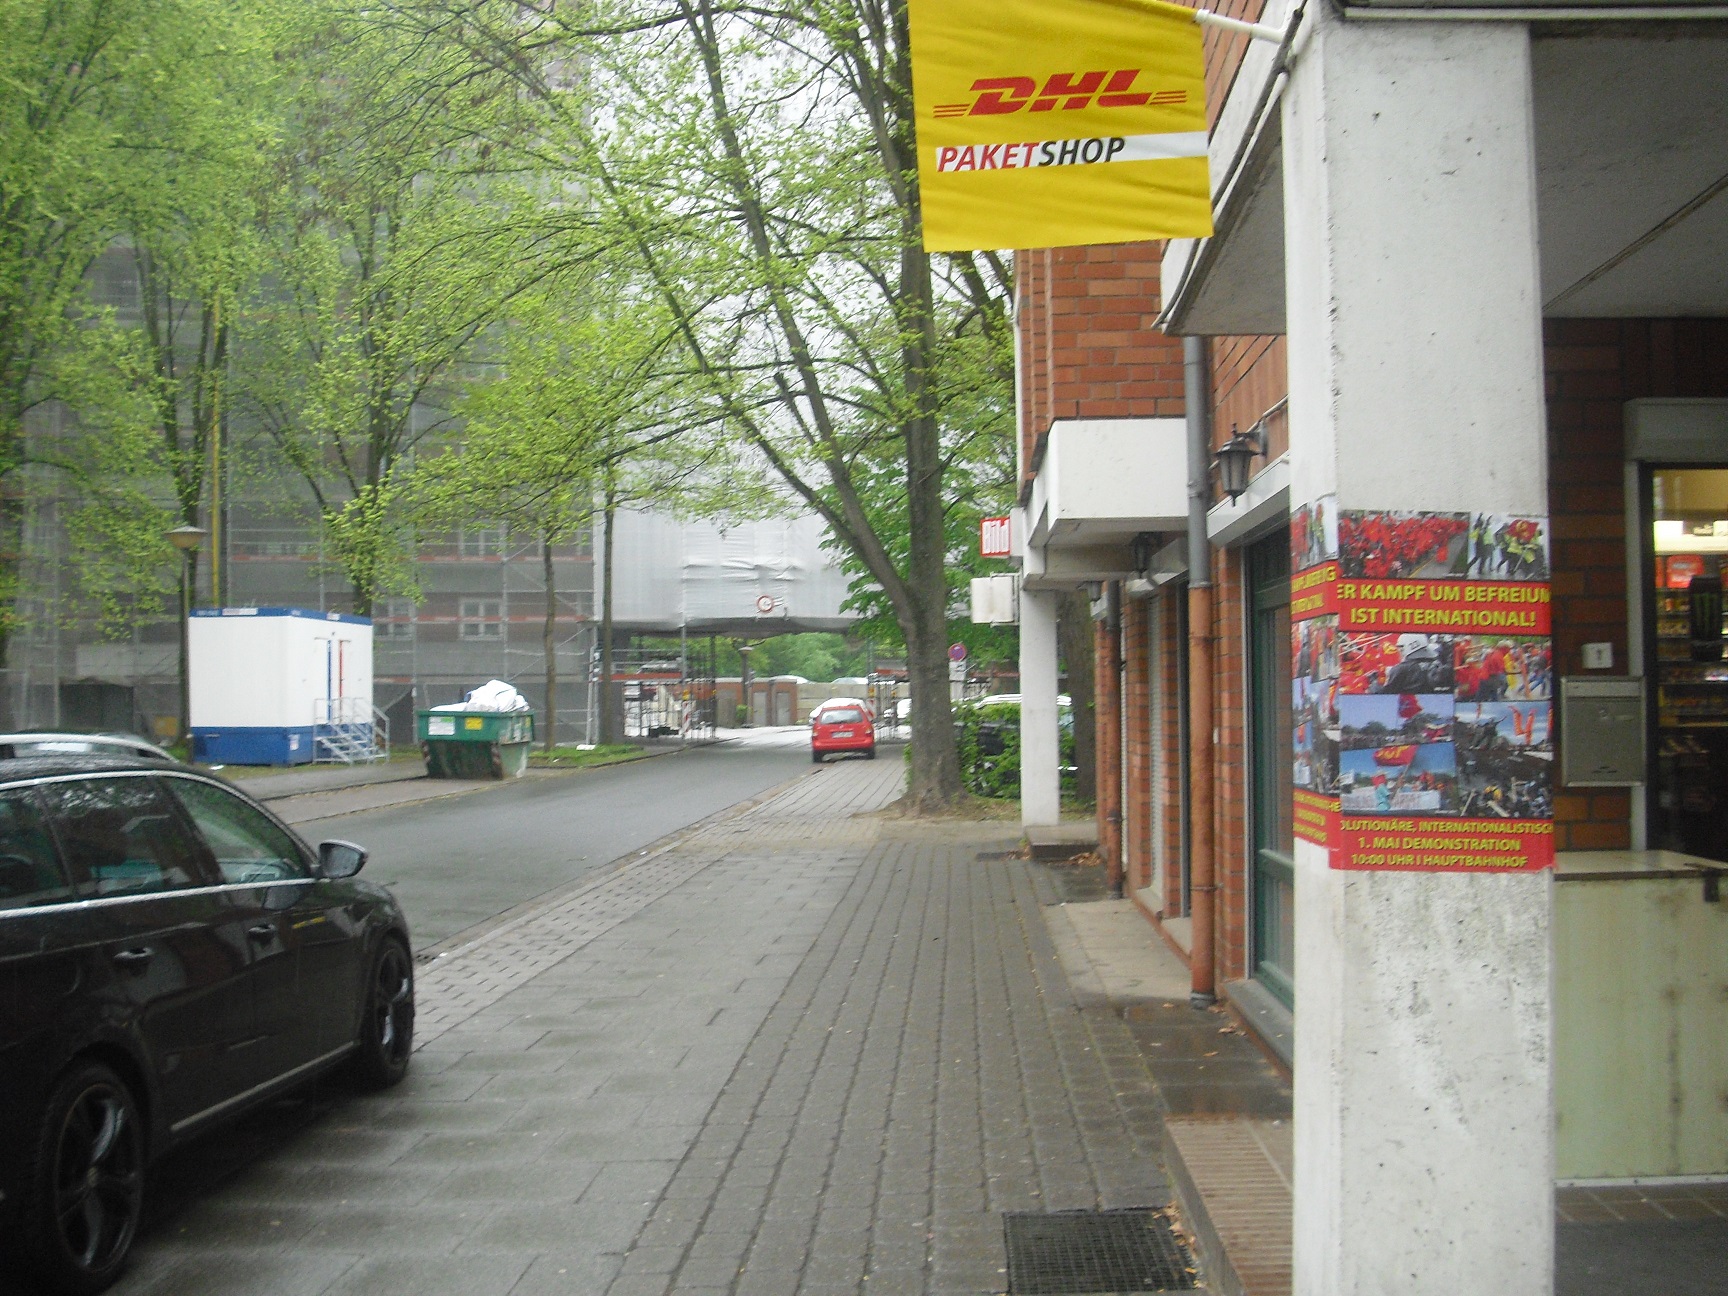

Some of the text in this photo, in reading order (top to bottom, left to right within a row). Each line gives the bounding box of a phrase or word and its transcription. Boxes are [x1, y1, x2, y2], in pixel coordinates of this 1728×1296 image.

[968, 69, 1152, 116] DHL
[937, 136, 1125, 172] PAKETSHOP
[1360, 584, 1426, 601] KAMPF
[1429, 586, 1460, 601] UM
[1350, 608, 1536, 627] IST INTERNATIONAL!
[1358, 837, 1521, 851] 1. MAI DEMONSTRATION
[1351, 853, 1385, 866] 10:00
[1387, 854, 1415, 866] UHR
[1423, 854, 1528, 868] HAUPTBAHNHOF
